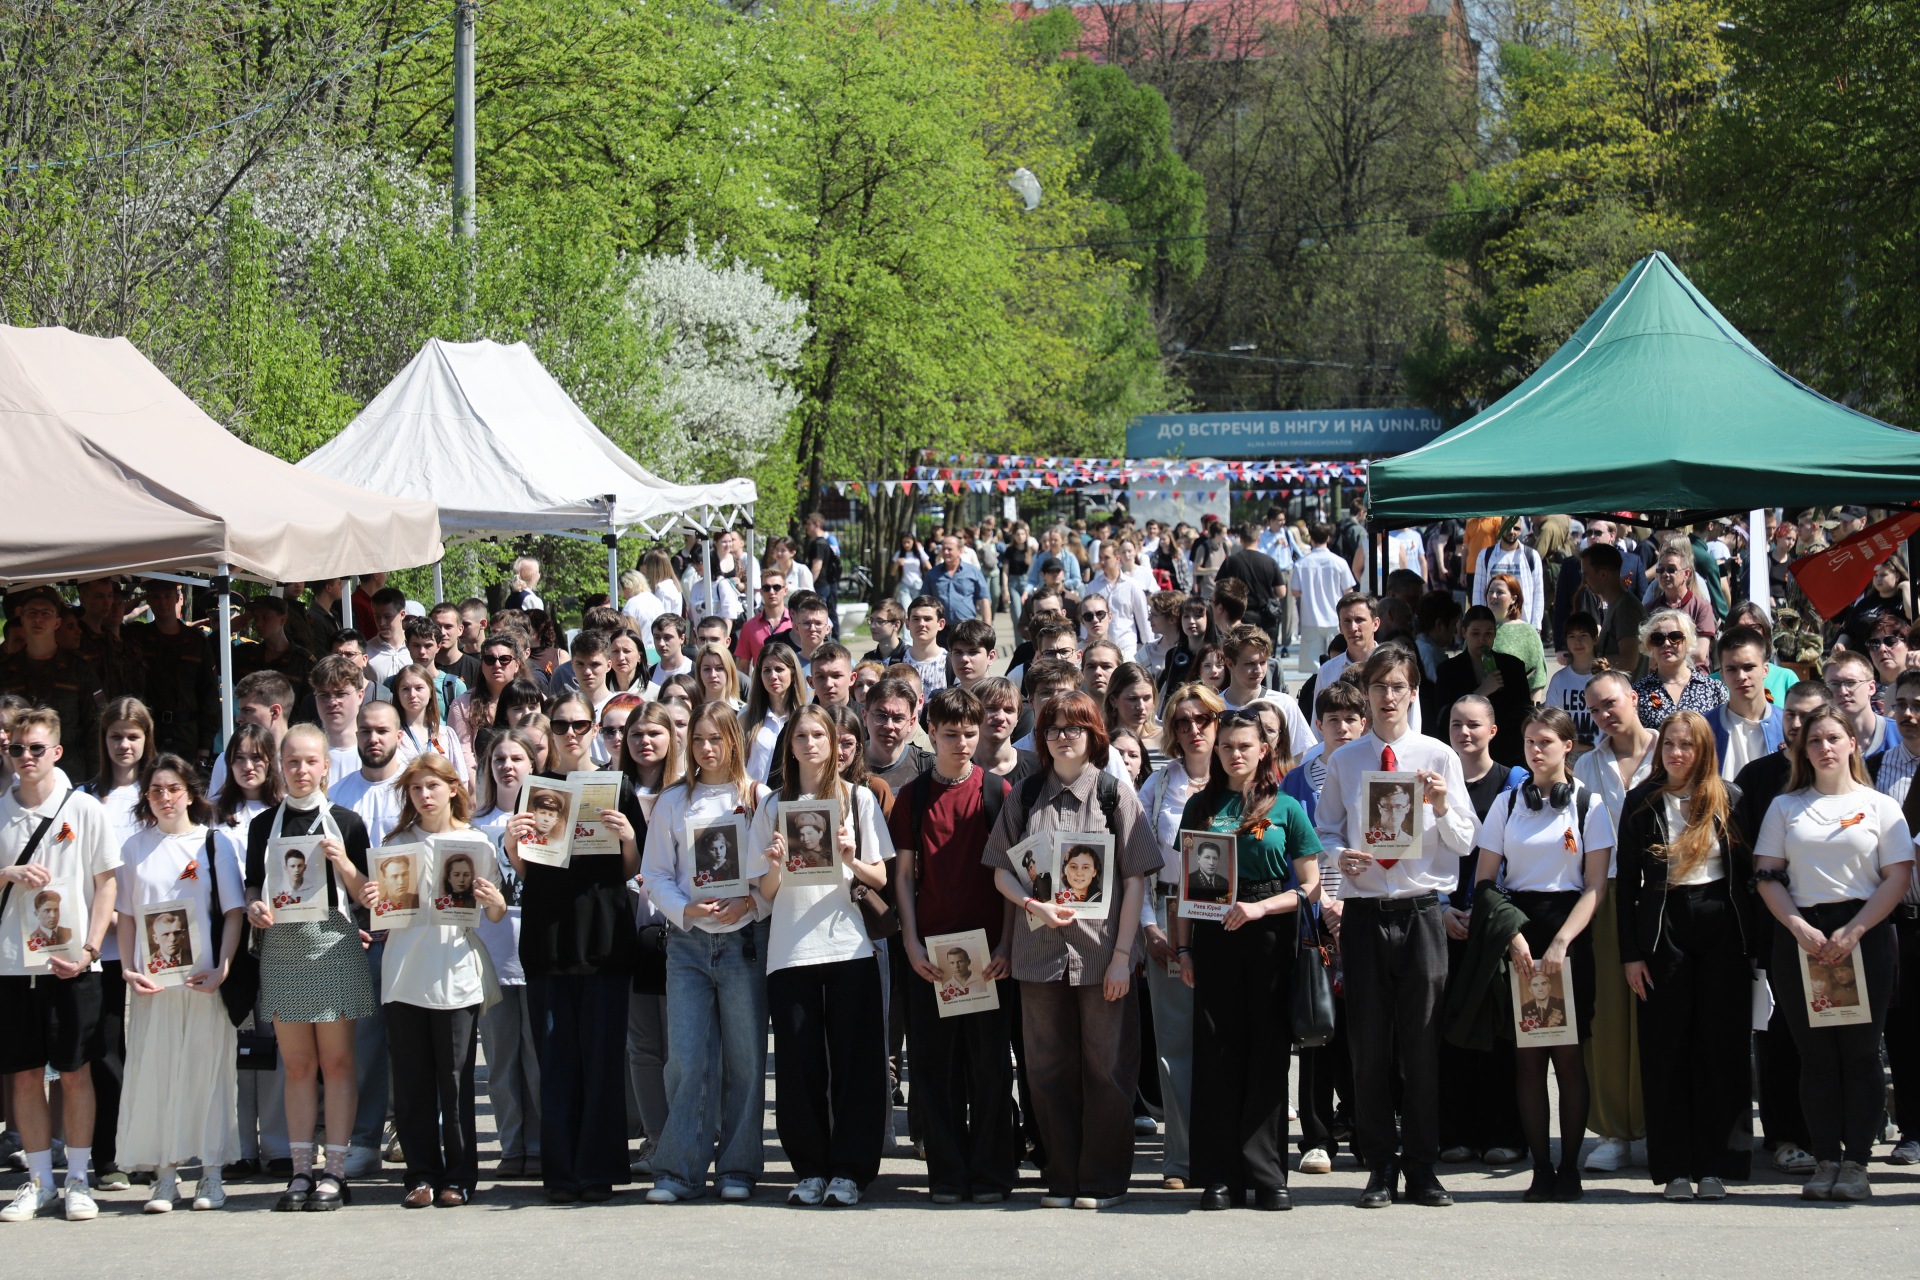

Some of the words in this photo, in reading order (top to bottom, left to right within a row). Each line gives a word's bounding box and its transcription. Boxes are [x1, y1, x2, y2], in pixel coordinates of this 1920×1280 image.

[1158, 423, 1184, 439] ДО
[1189, 421, 1264, 436] ВСТРЕЧИ
[1270, 421, 1280, 434] В
[1285, 420, 1329, 434] ННГУ
[1334, 420, 1345, 433] И
[1351, 419, 1374, 432] НА
[1379, 418, 1441, 432] UNN.RU
